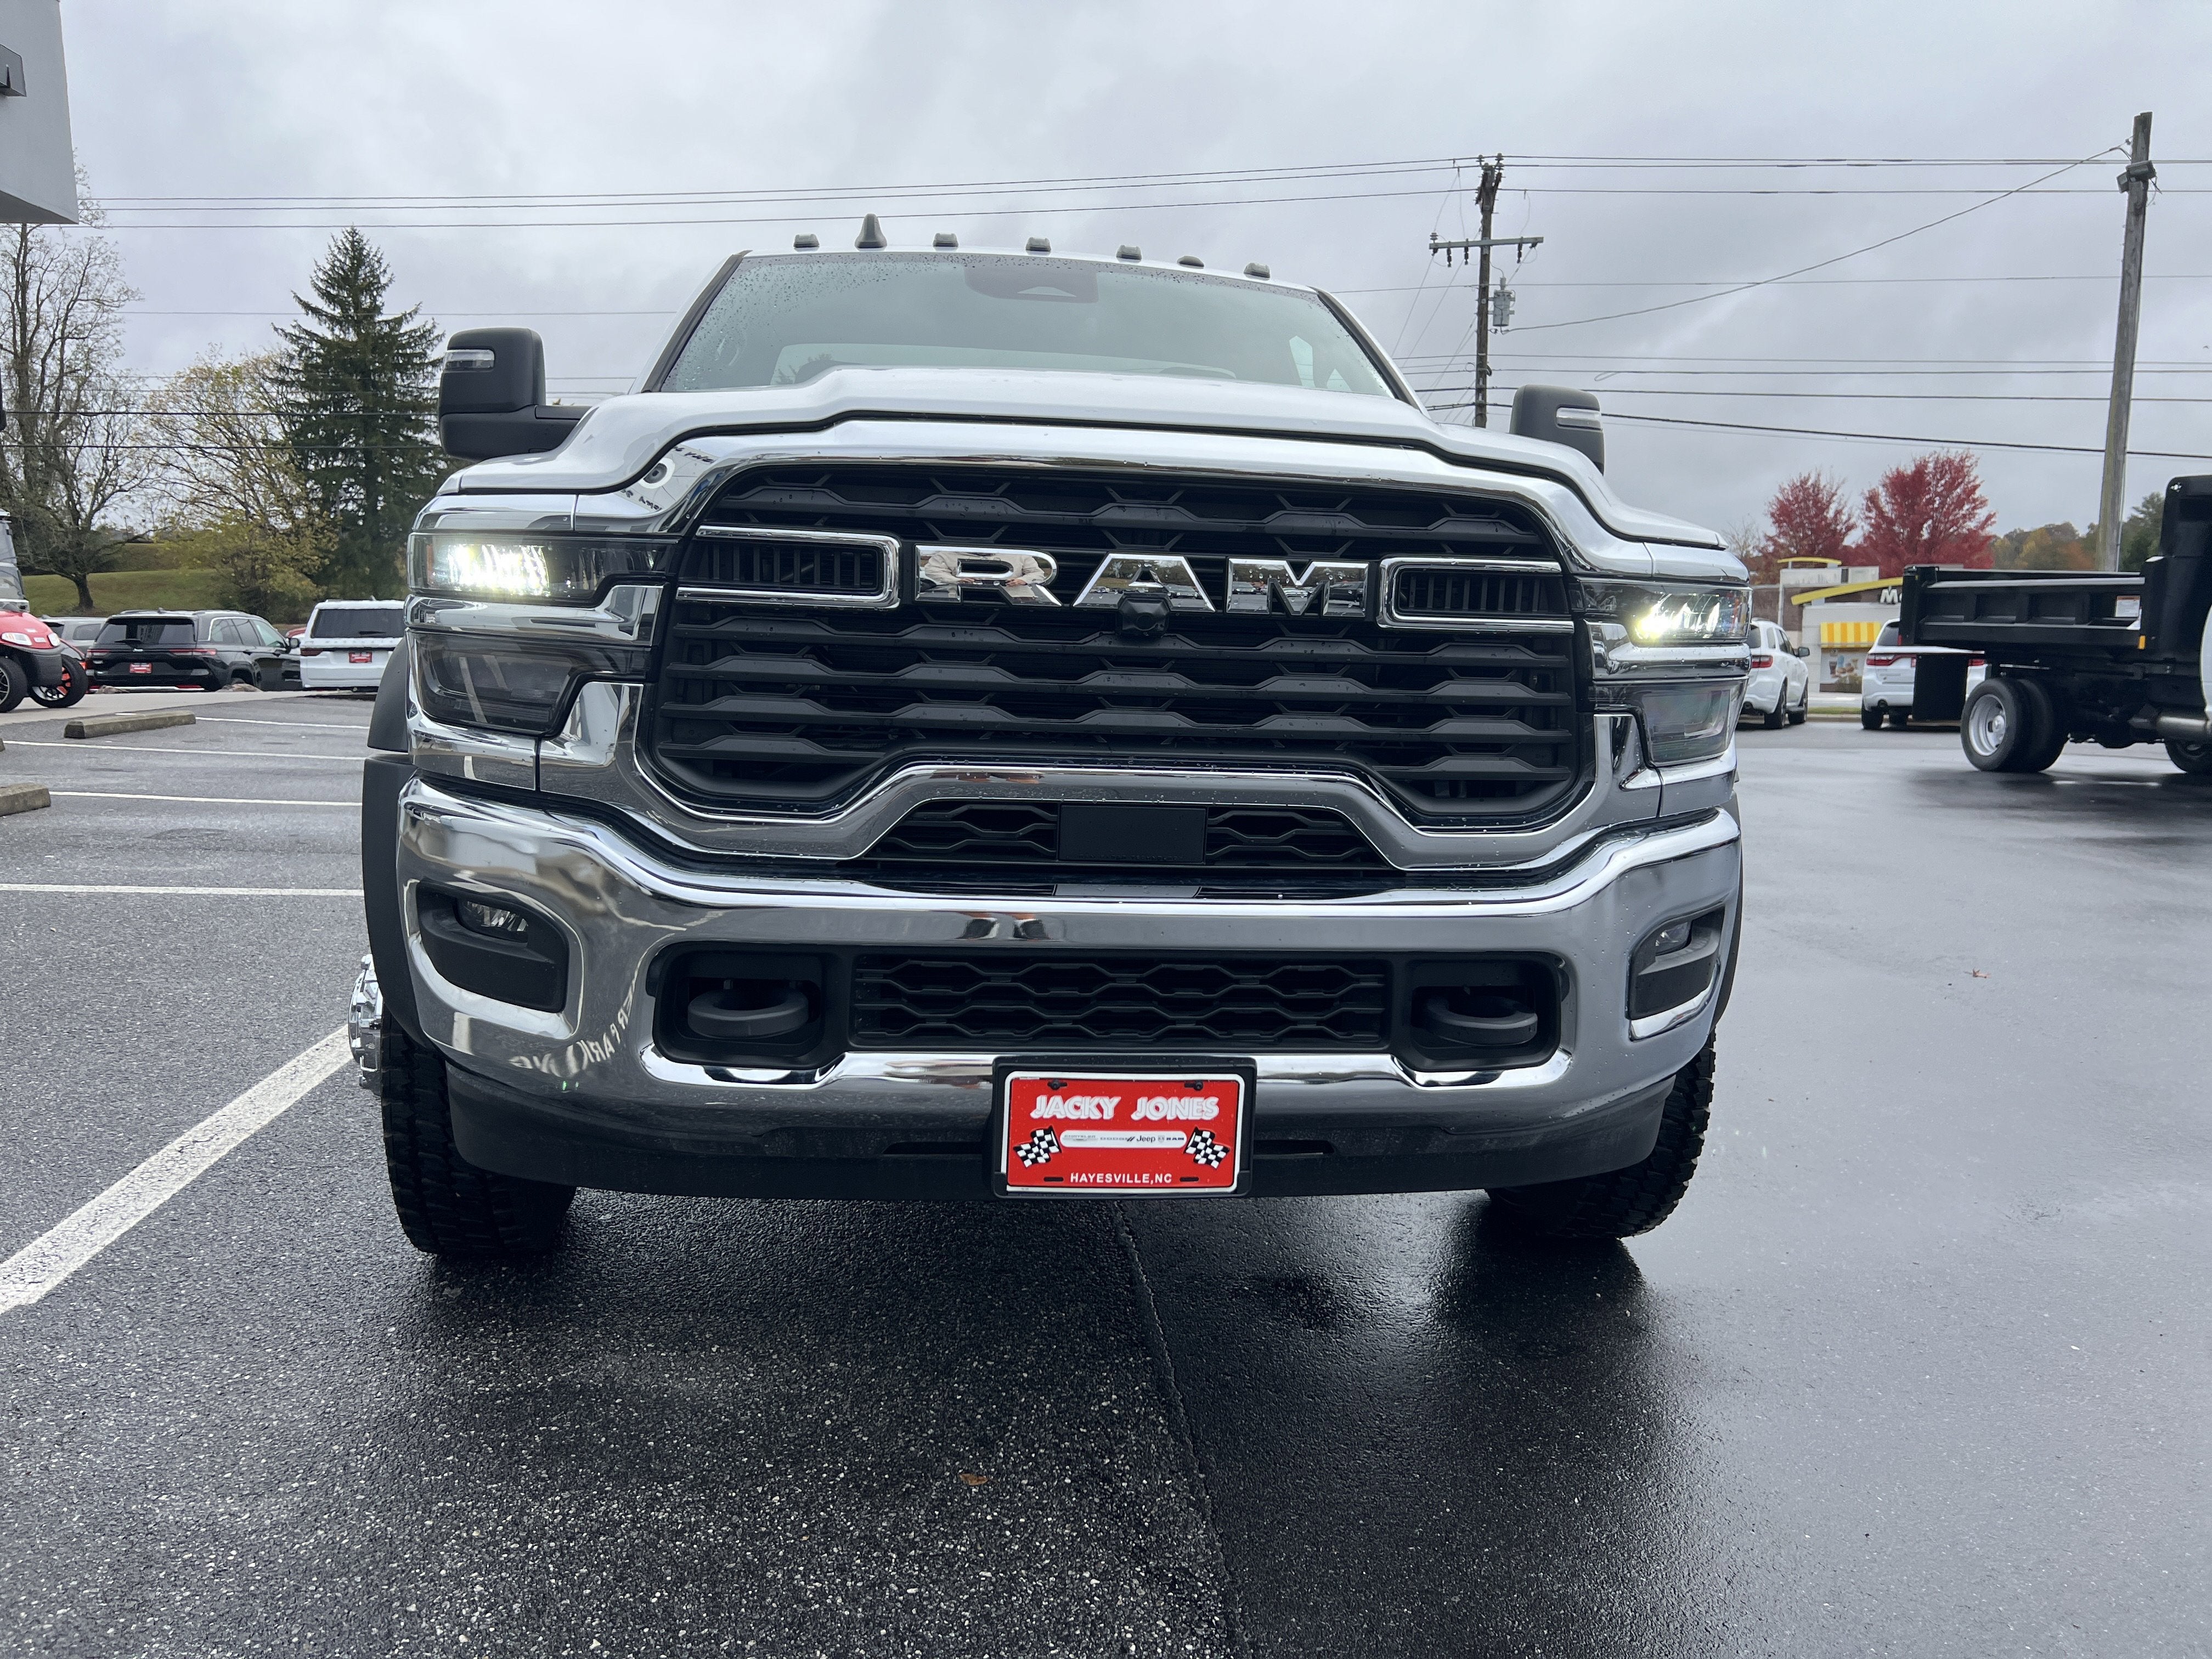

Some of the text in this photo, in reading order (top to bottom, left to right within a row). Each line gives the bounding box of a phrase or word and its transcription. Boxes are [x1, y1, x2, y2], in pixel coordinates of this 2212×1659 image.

[915, 544, 1371, 618] RAM
[1030, 1095, 1219, 1121] JACKY JONES
